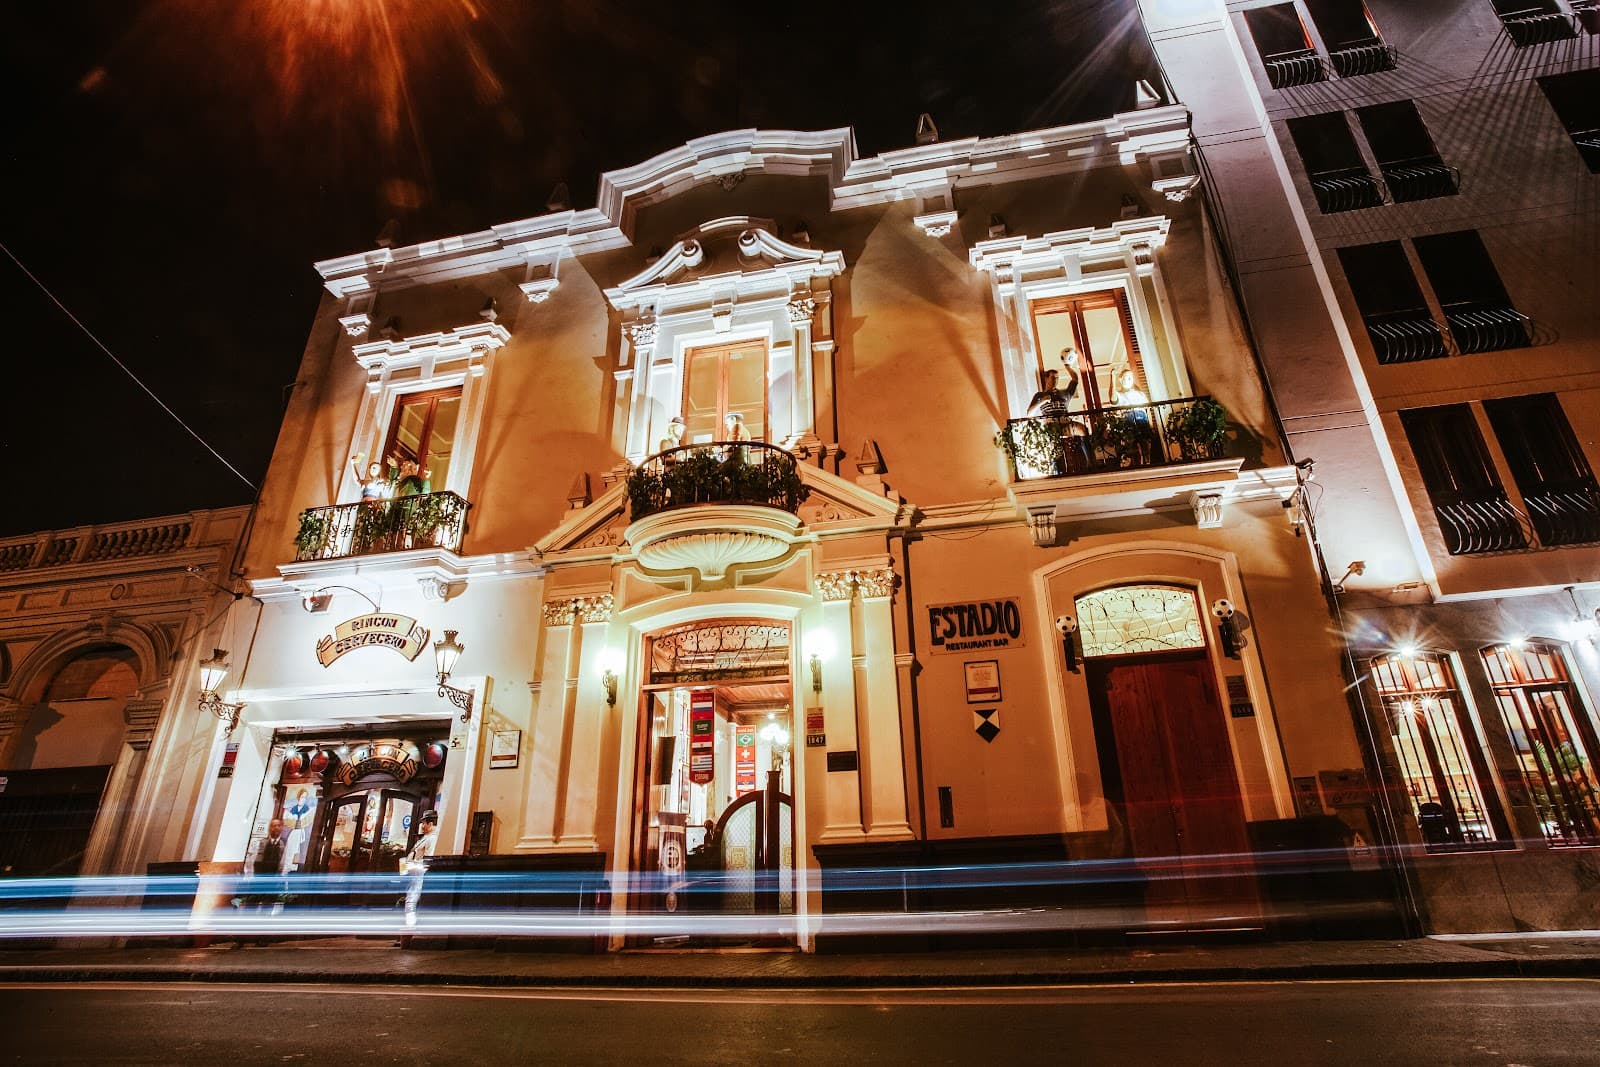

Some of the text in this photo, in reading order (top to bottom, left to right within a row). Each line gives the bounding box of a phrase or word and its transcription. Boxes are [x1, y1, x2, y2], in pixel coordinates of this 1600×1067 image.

[351, 617, 398, 631] RINCON
[928, 600, 1021, 646] ESTADIO
[335, 633, 407, 654] CERVECERO
[945, 638, 1009, 652] RESTAURANT BAR
